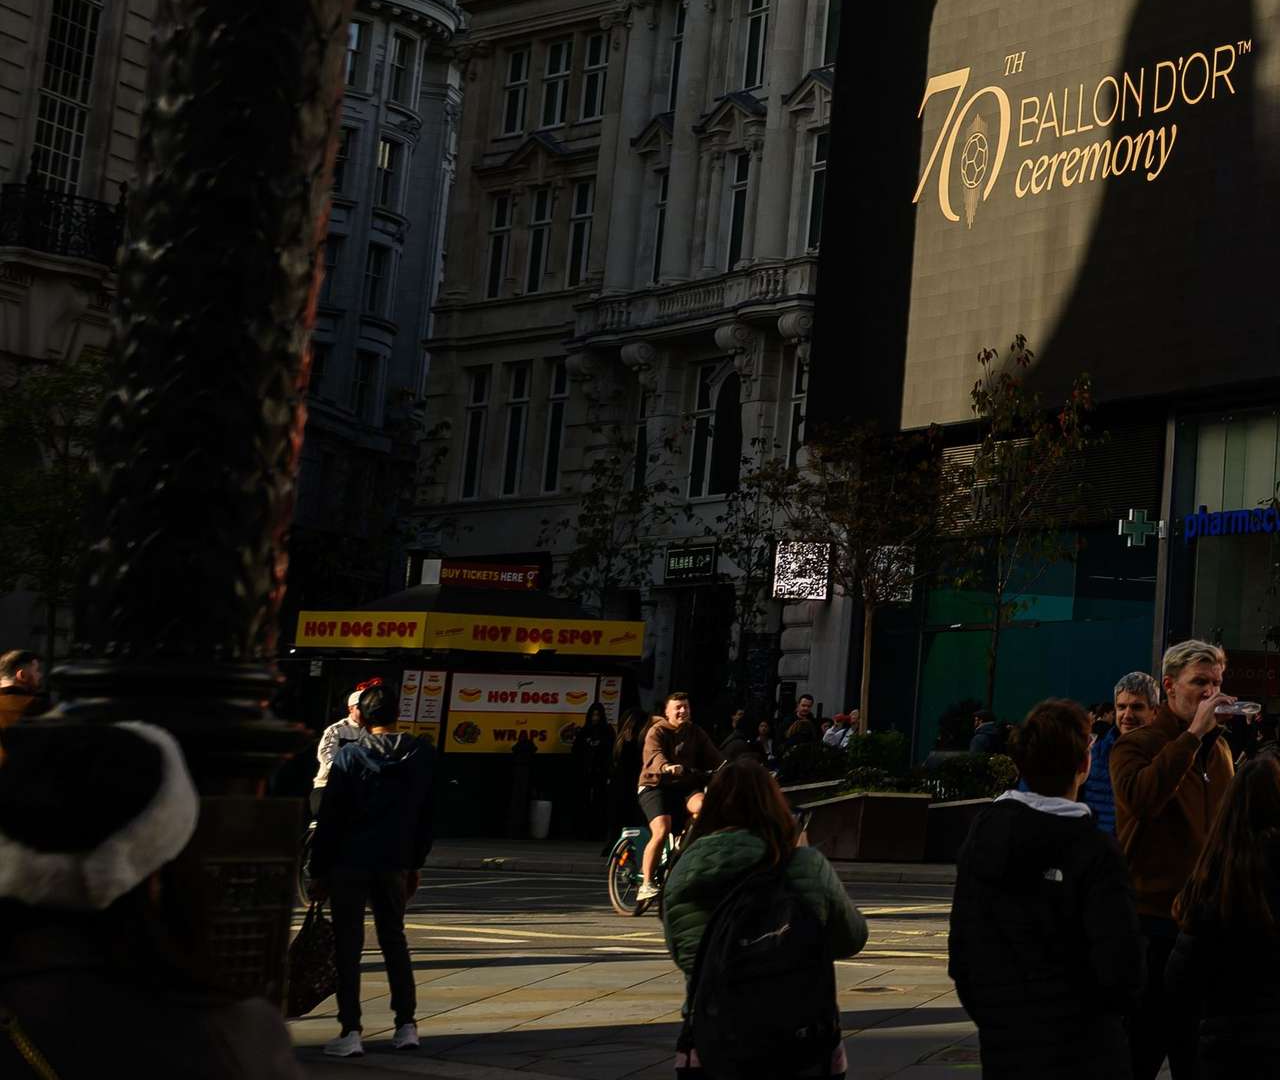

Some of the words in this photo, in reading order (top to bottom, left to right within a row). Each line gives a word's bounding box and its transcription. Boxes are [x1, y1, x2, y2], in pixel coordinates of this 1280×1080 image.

[1017, 67, 1145, 147] BALLON
[1015, 123, 1177, 200] ceremony
[441, 567, 461, 579] BUY
[462, 569, 499, 581] TICKETS
[500, 571, 523, 583] HERE
[304, 621, 337, 637] HOT
[340, 621, 372, 638] DOG
[376, 622, 417, 637] SPOT
[473, 624, 510, 641] HOT
[515, 626, 553, 644] DOG
[558, 628, 603, 645] SPOT
[488, 690, 517, 703] HOT
[521, 691, 560, 704] DOGS
[493, 728, 548, 742] WRAPS
